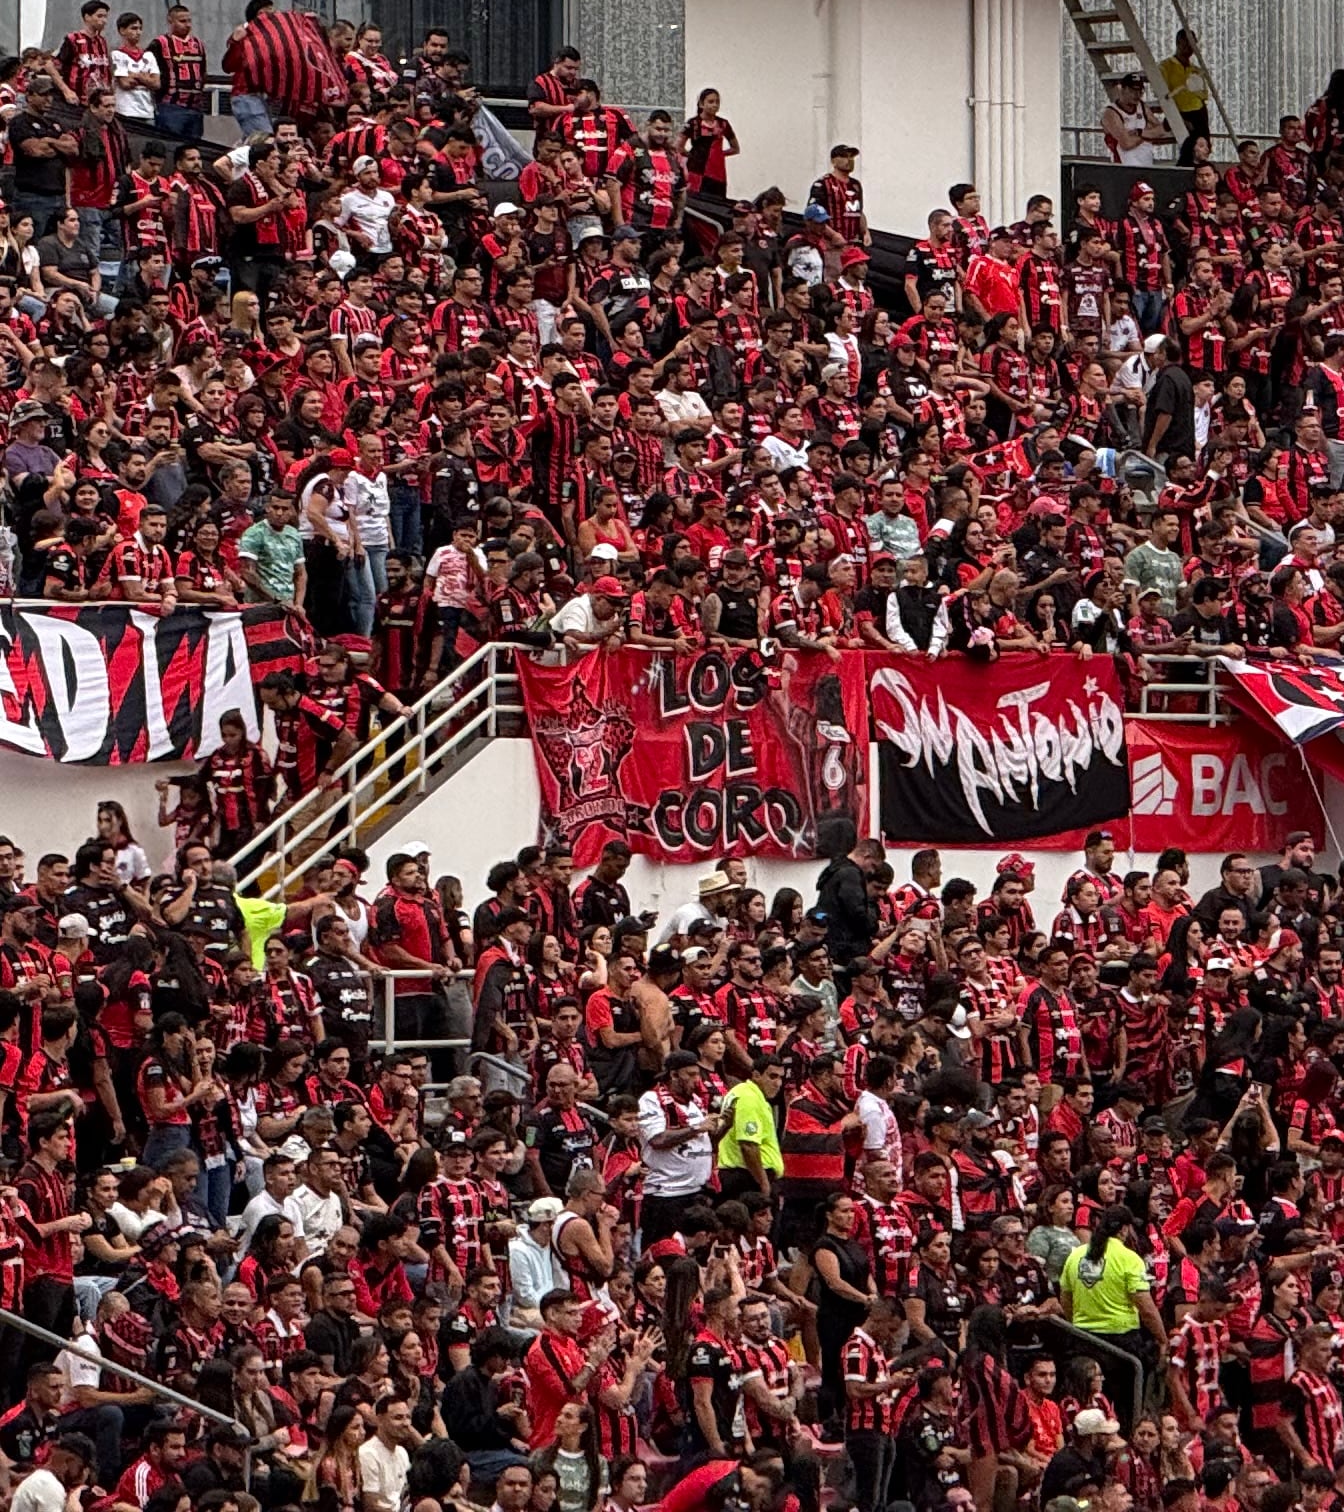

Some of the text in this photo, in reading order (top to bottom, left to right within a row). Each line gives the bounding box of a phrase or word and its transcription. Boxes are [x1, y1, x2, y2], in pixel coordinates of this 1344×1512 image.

[660, 651, 769, 718] LOS
[683, 718, 758, 782] DE
[1192, 753, 1287, 816] BAC
